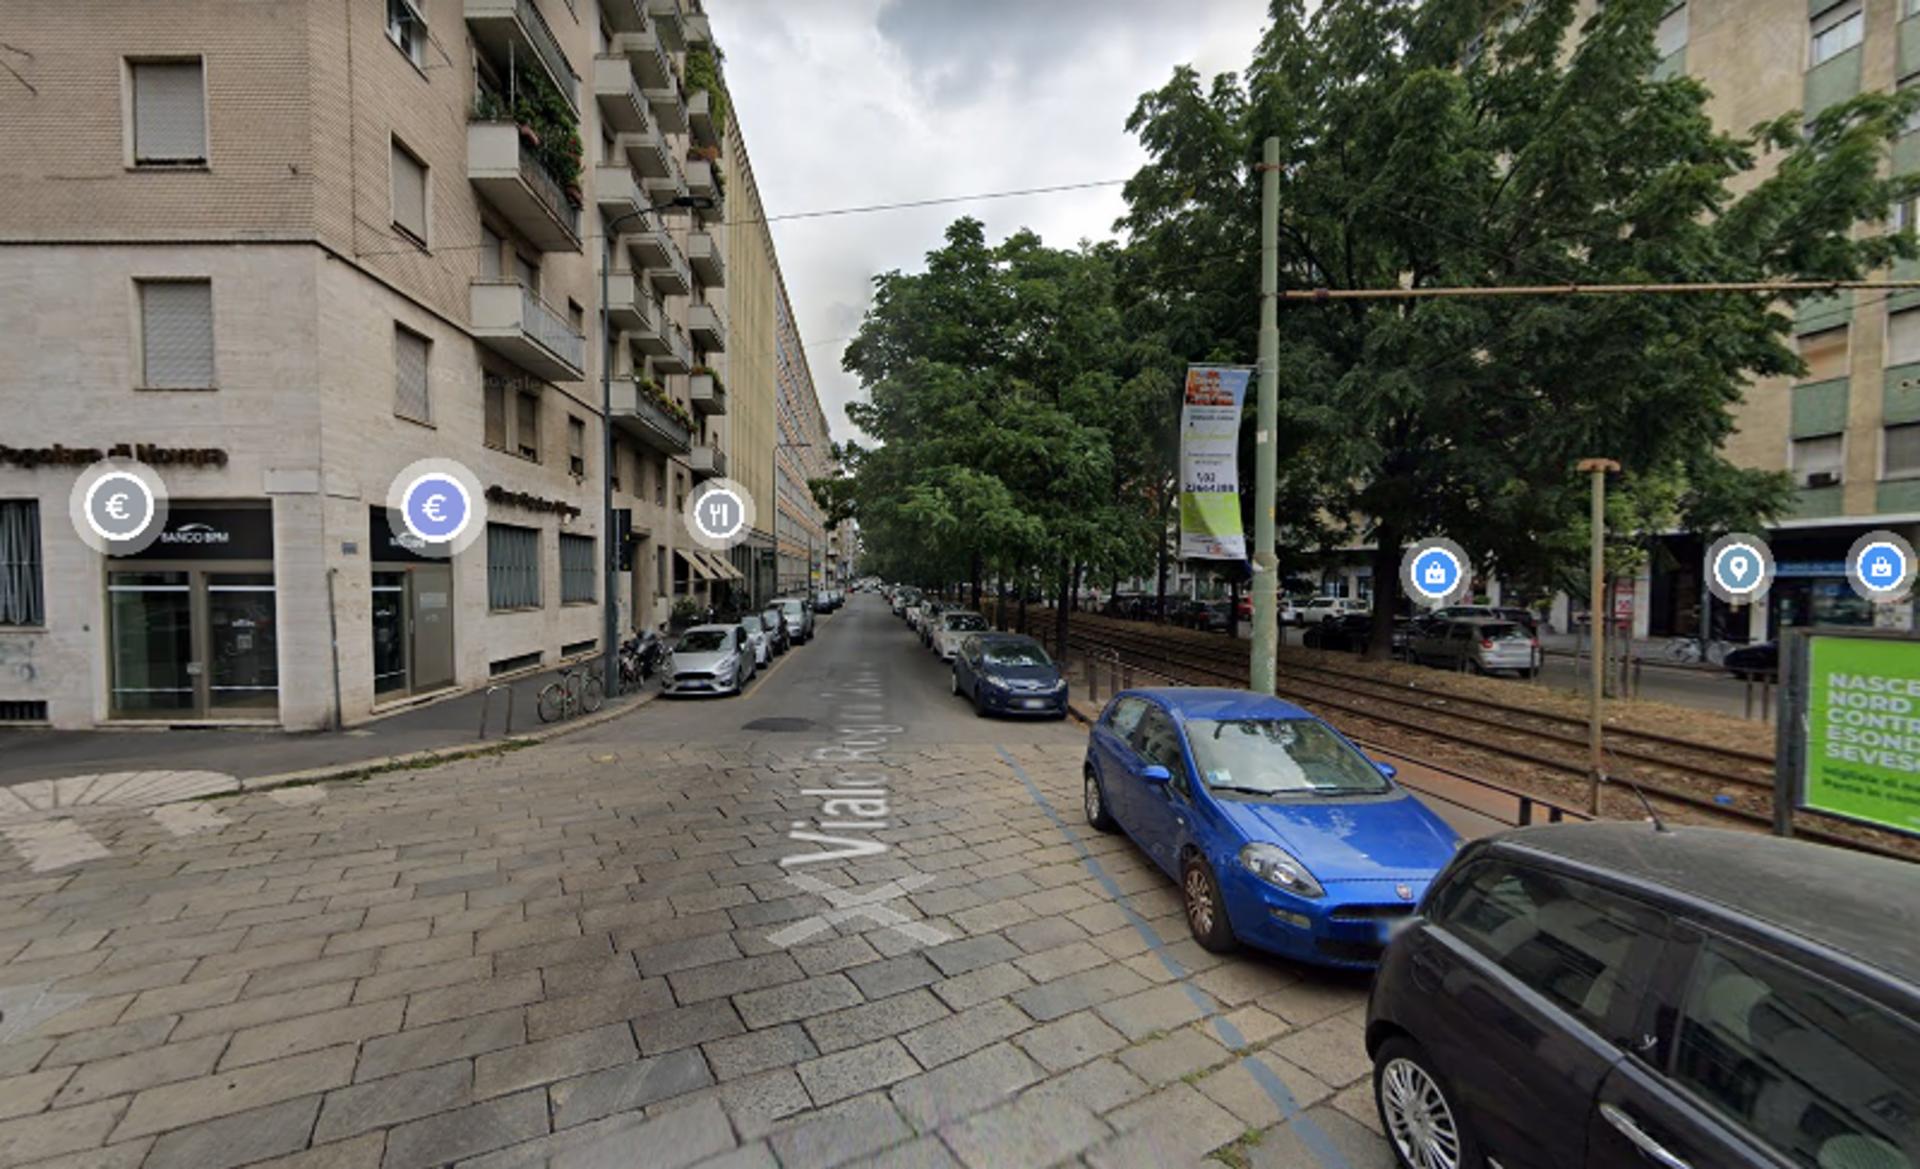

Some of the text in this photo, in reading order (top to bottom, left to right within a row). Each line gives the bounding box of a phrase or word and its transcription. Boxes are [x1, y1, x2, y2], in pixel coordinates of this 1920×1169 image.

[161, 532, 229, 544] BANCO BPM
[1828, 673, 1920, 697] NASCE
[1828, 691, 1911, 713] NORD
[1826, 743, 1920, 771] SEVES
